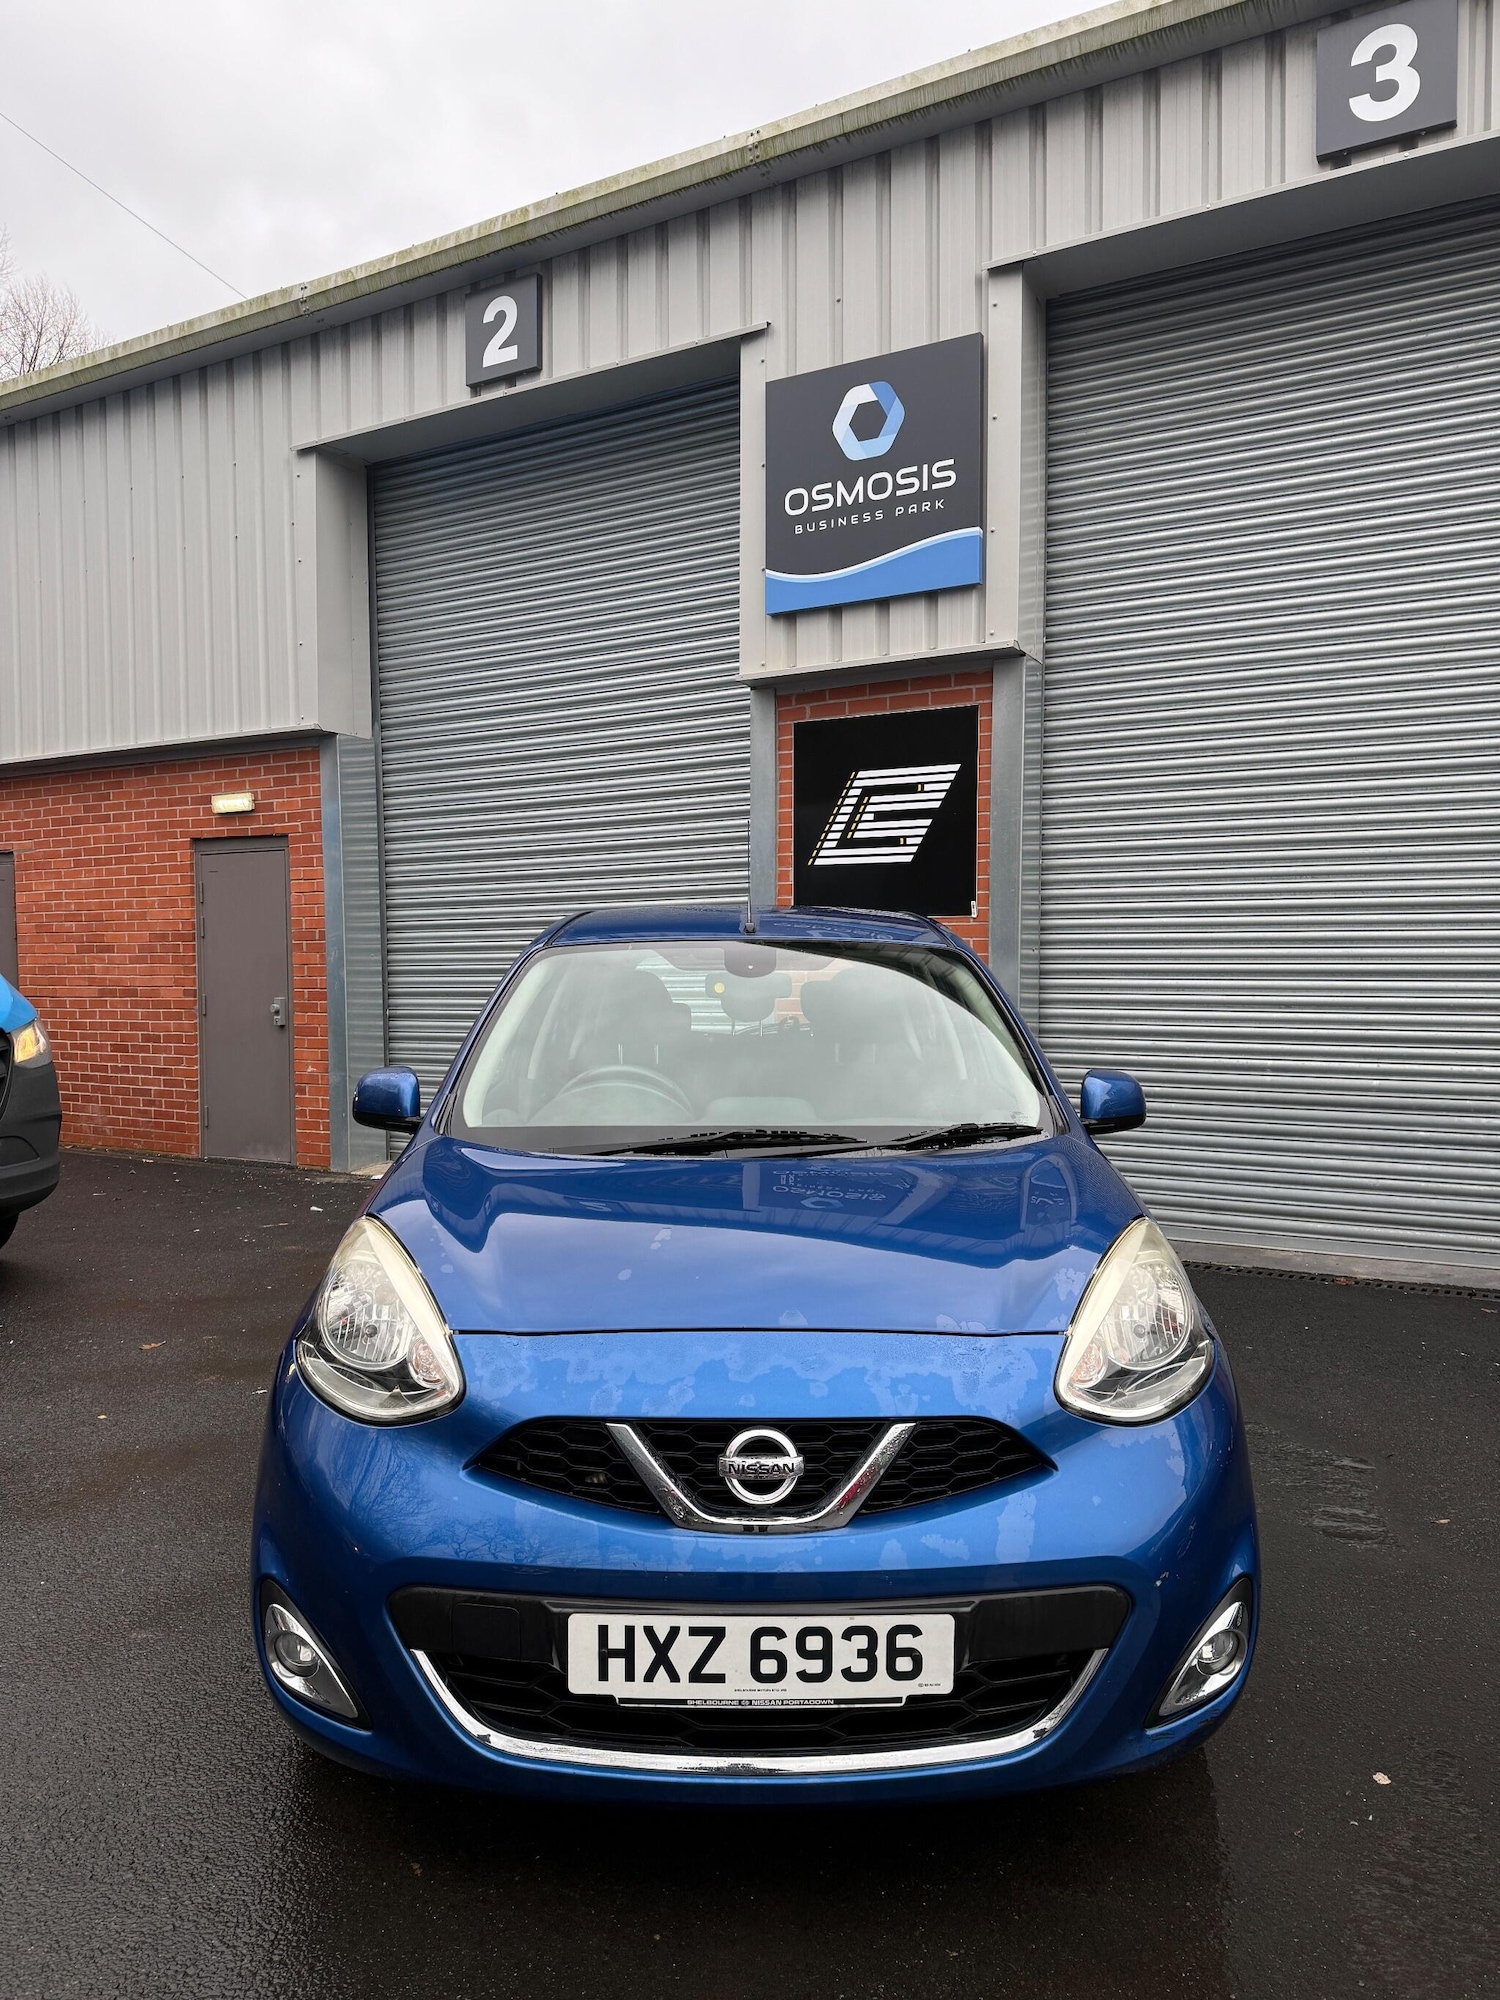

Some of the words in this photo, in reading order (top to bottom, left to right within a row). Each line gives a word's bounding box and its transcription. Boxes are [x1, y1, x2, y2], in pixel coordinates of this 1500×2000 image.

[1349, 23, 1420, 122] 3
[483, 295, 518, 368] 2
[784, 459, 957, 516] OSMOSIS
[795, 510, 885, 534] BUSINESS
[895, 499, 945, 516] PARK
[728, 1461, 795, 1475] NISSAN
[598, 1624, 727, 1683] HXZ
[750, 1624, 924, 1683] 6936
